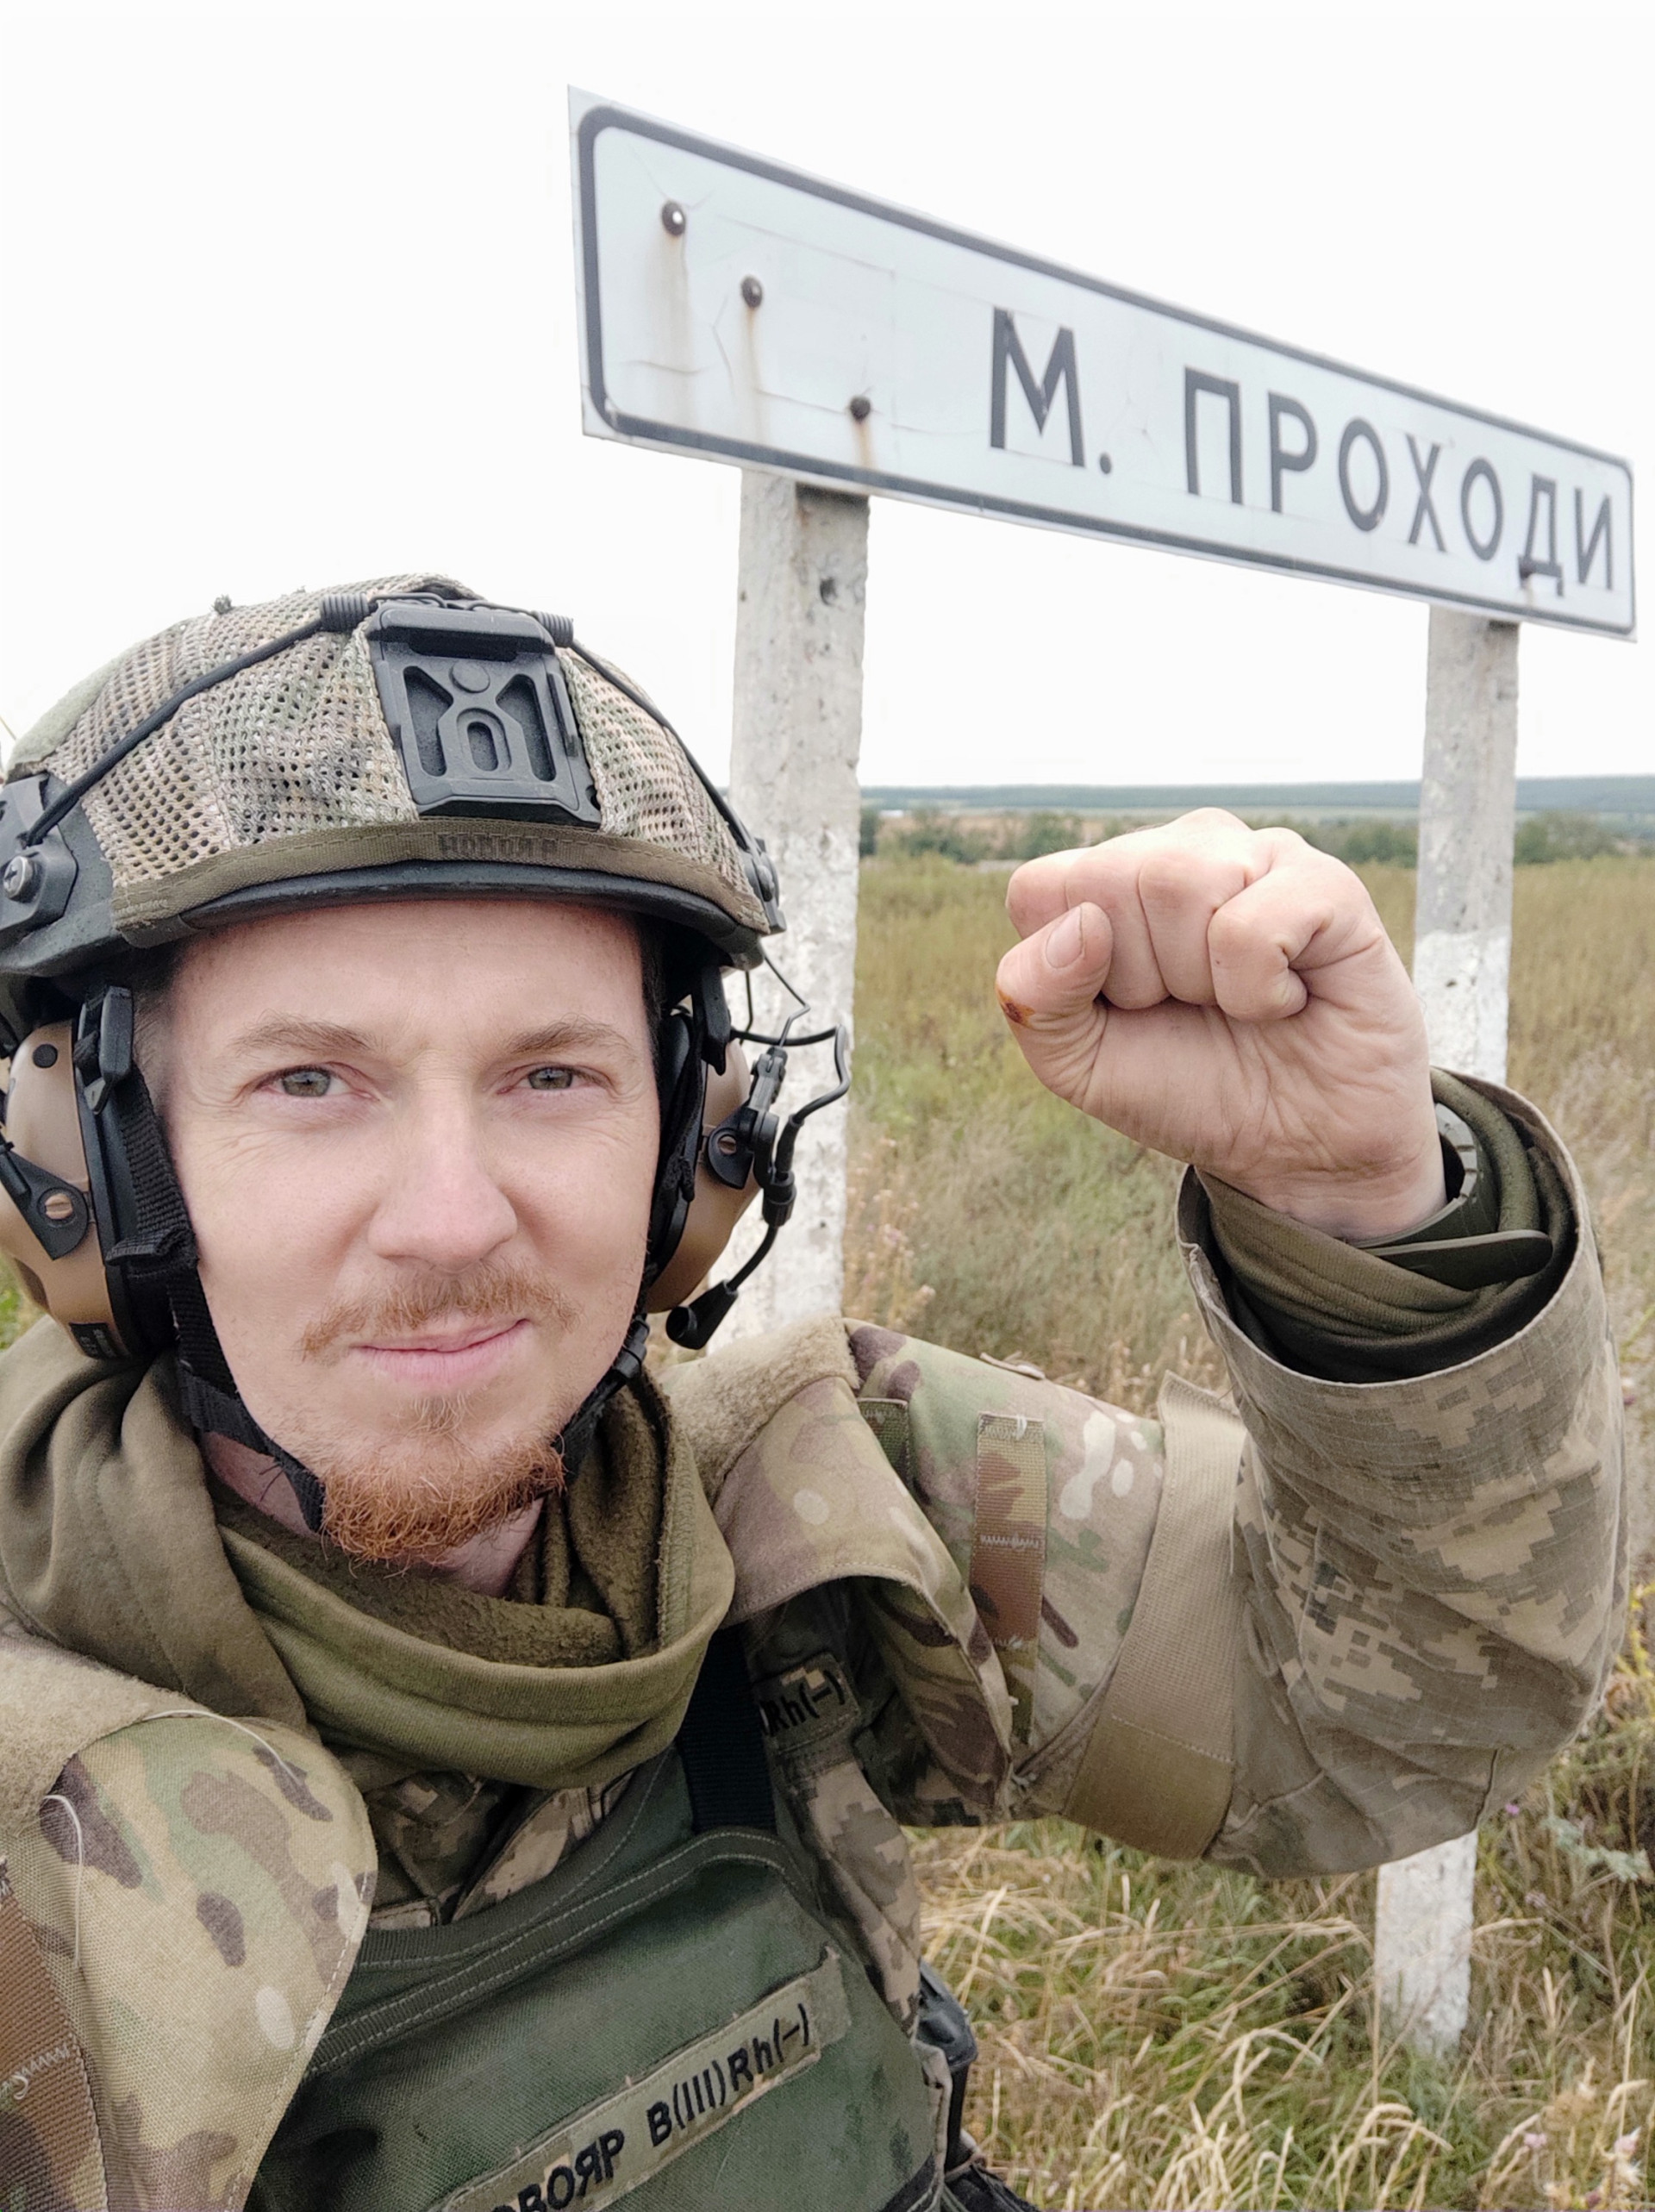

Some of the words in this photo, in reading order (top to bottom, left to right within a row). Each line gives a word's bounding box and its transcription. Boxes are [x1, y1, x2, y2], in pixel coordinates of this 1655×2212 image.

[990, 306, 1114, 475] М.
[1183, 365, 1614, 597] ПРОХОДИ
[760, 1670, 845, 1737] Rh(-)
[492, 2129, 625, 2212] ВОЯР
